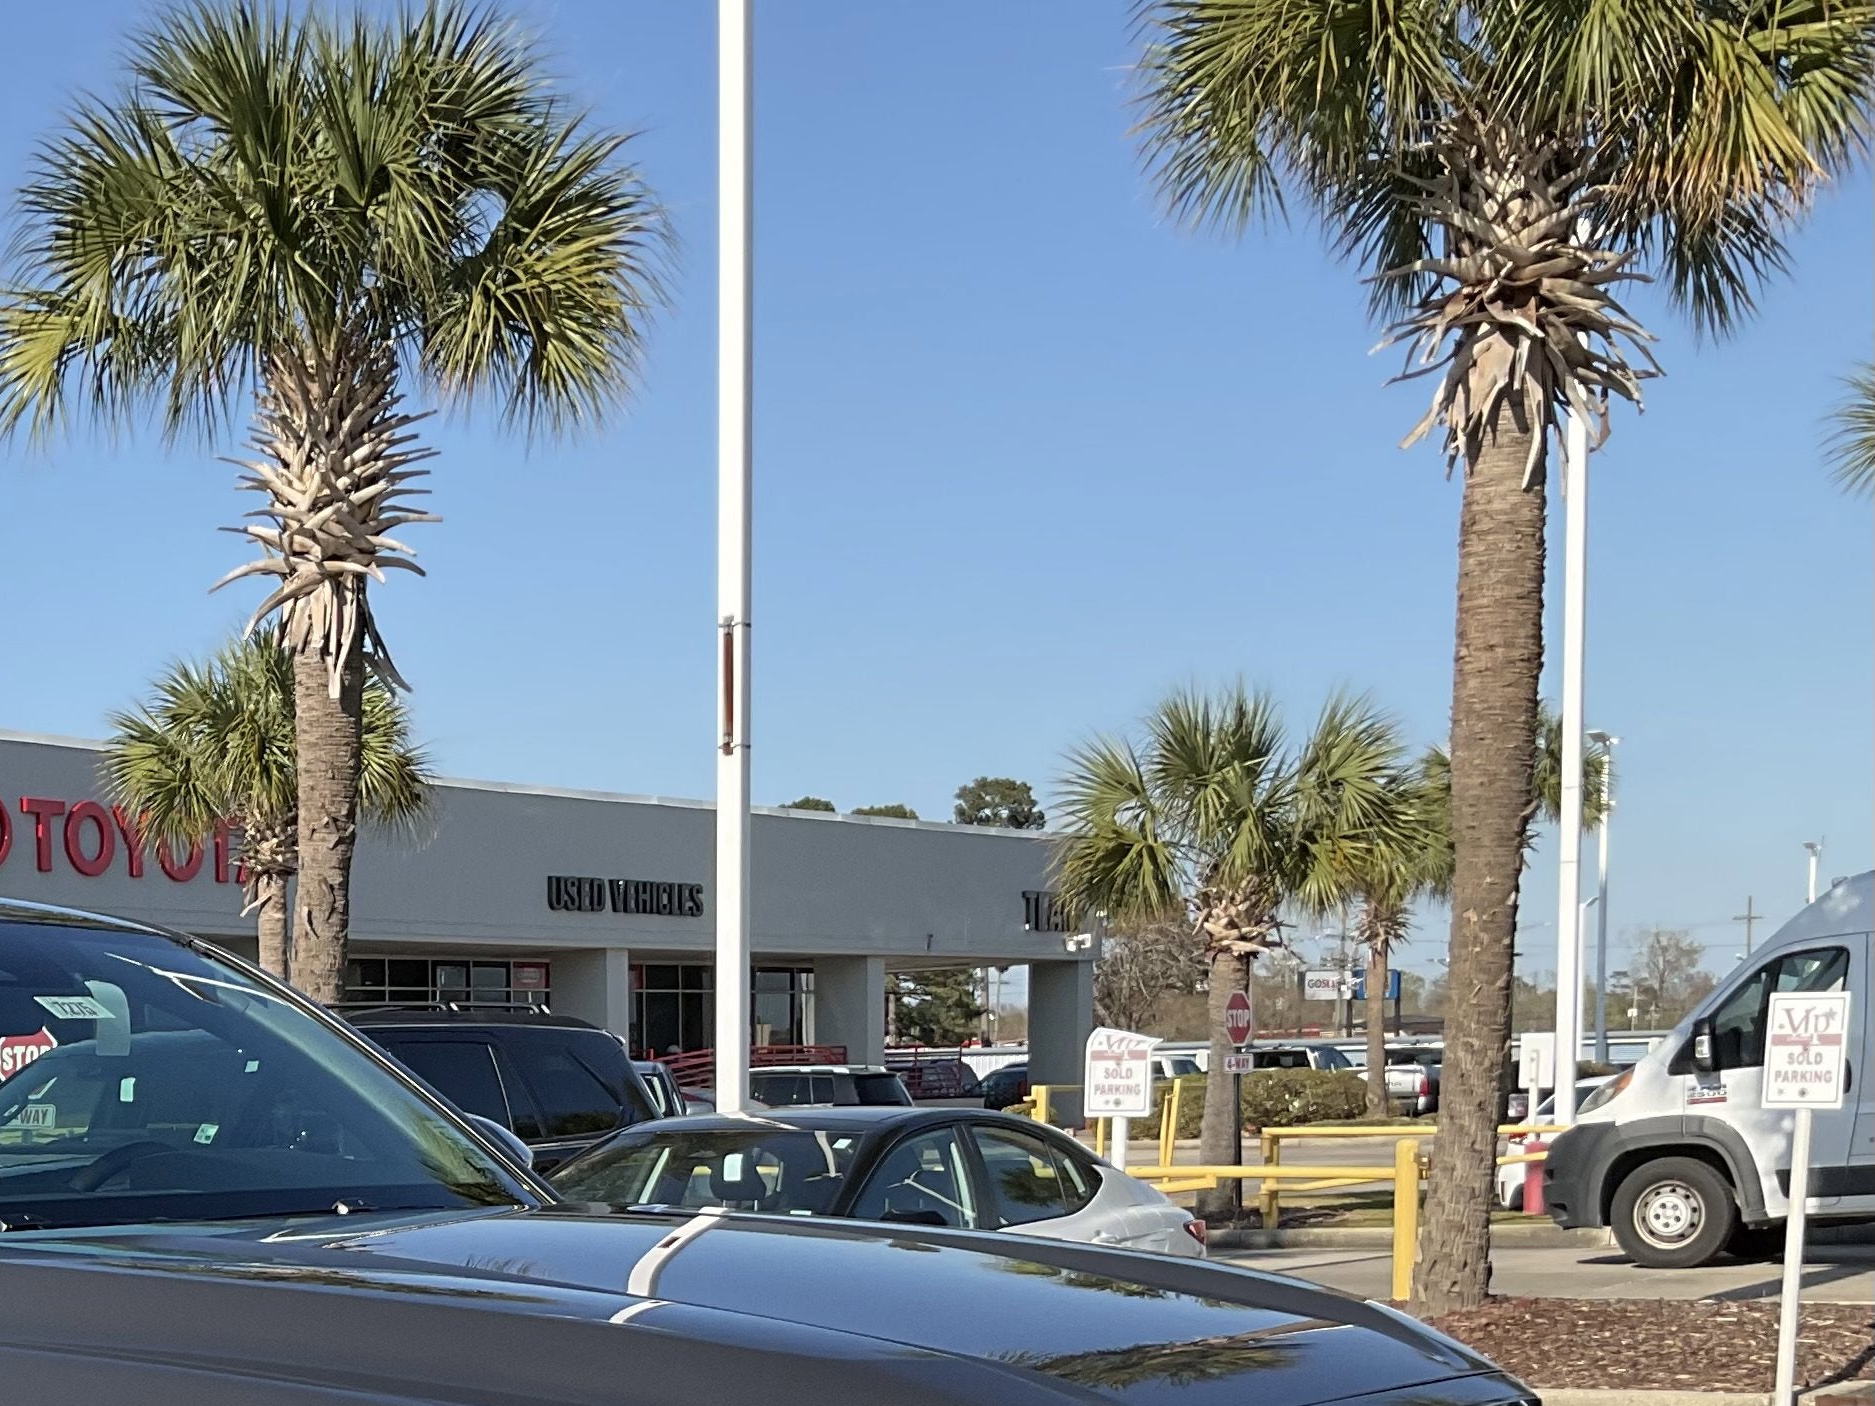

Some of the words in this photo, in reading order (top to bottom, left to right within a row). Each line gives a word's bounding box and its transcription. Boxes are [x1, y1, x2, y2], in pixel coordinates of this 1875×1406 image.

[547, 875, 606, 912] USED
[608, 879, 704, 917] VEHICLES
[1227, 1009, 1250, 1028] STOP
[1227, 1057, 1250, 1071] 4-WAY
[1787, 1052, 1824, 1066] SOLD
[1103, 1067, 1134, 1080] SOLD
[1774, 1070, 1833, 1084] PARKING
[1093, 1083, 1142, 1096] PARKING
